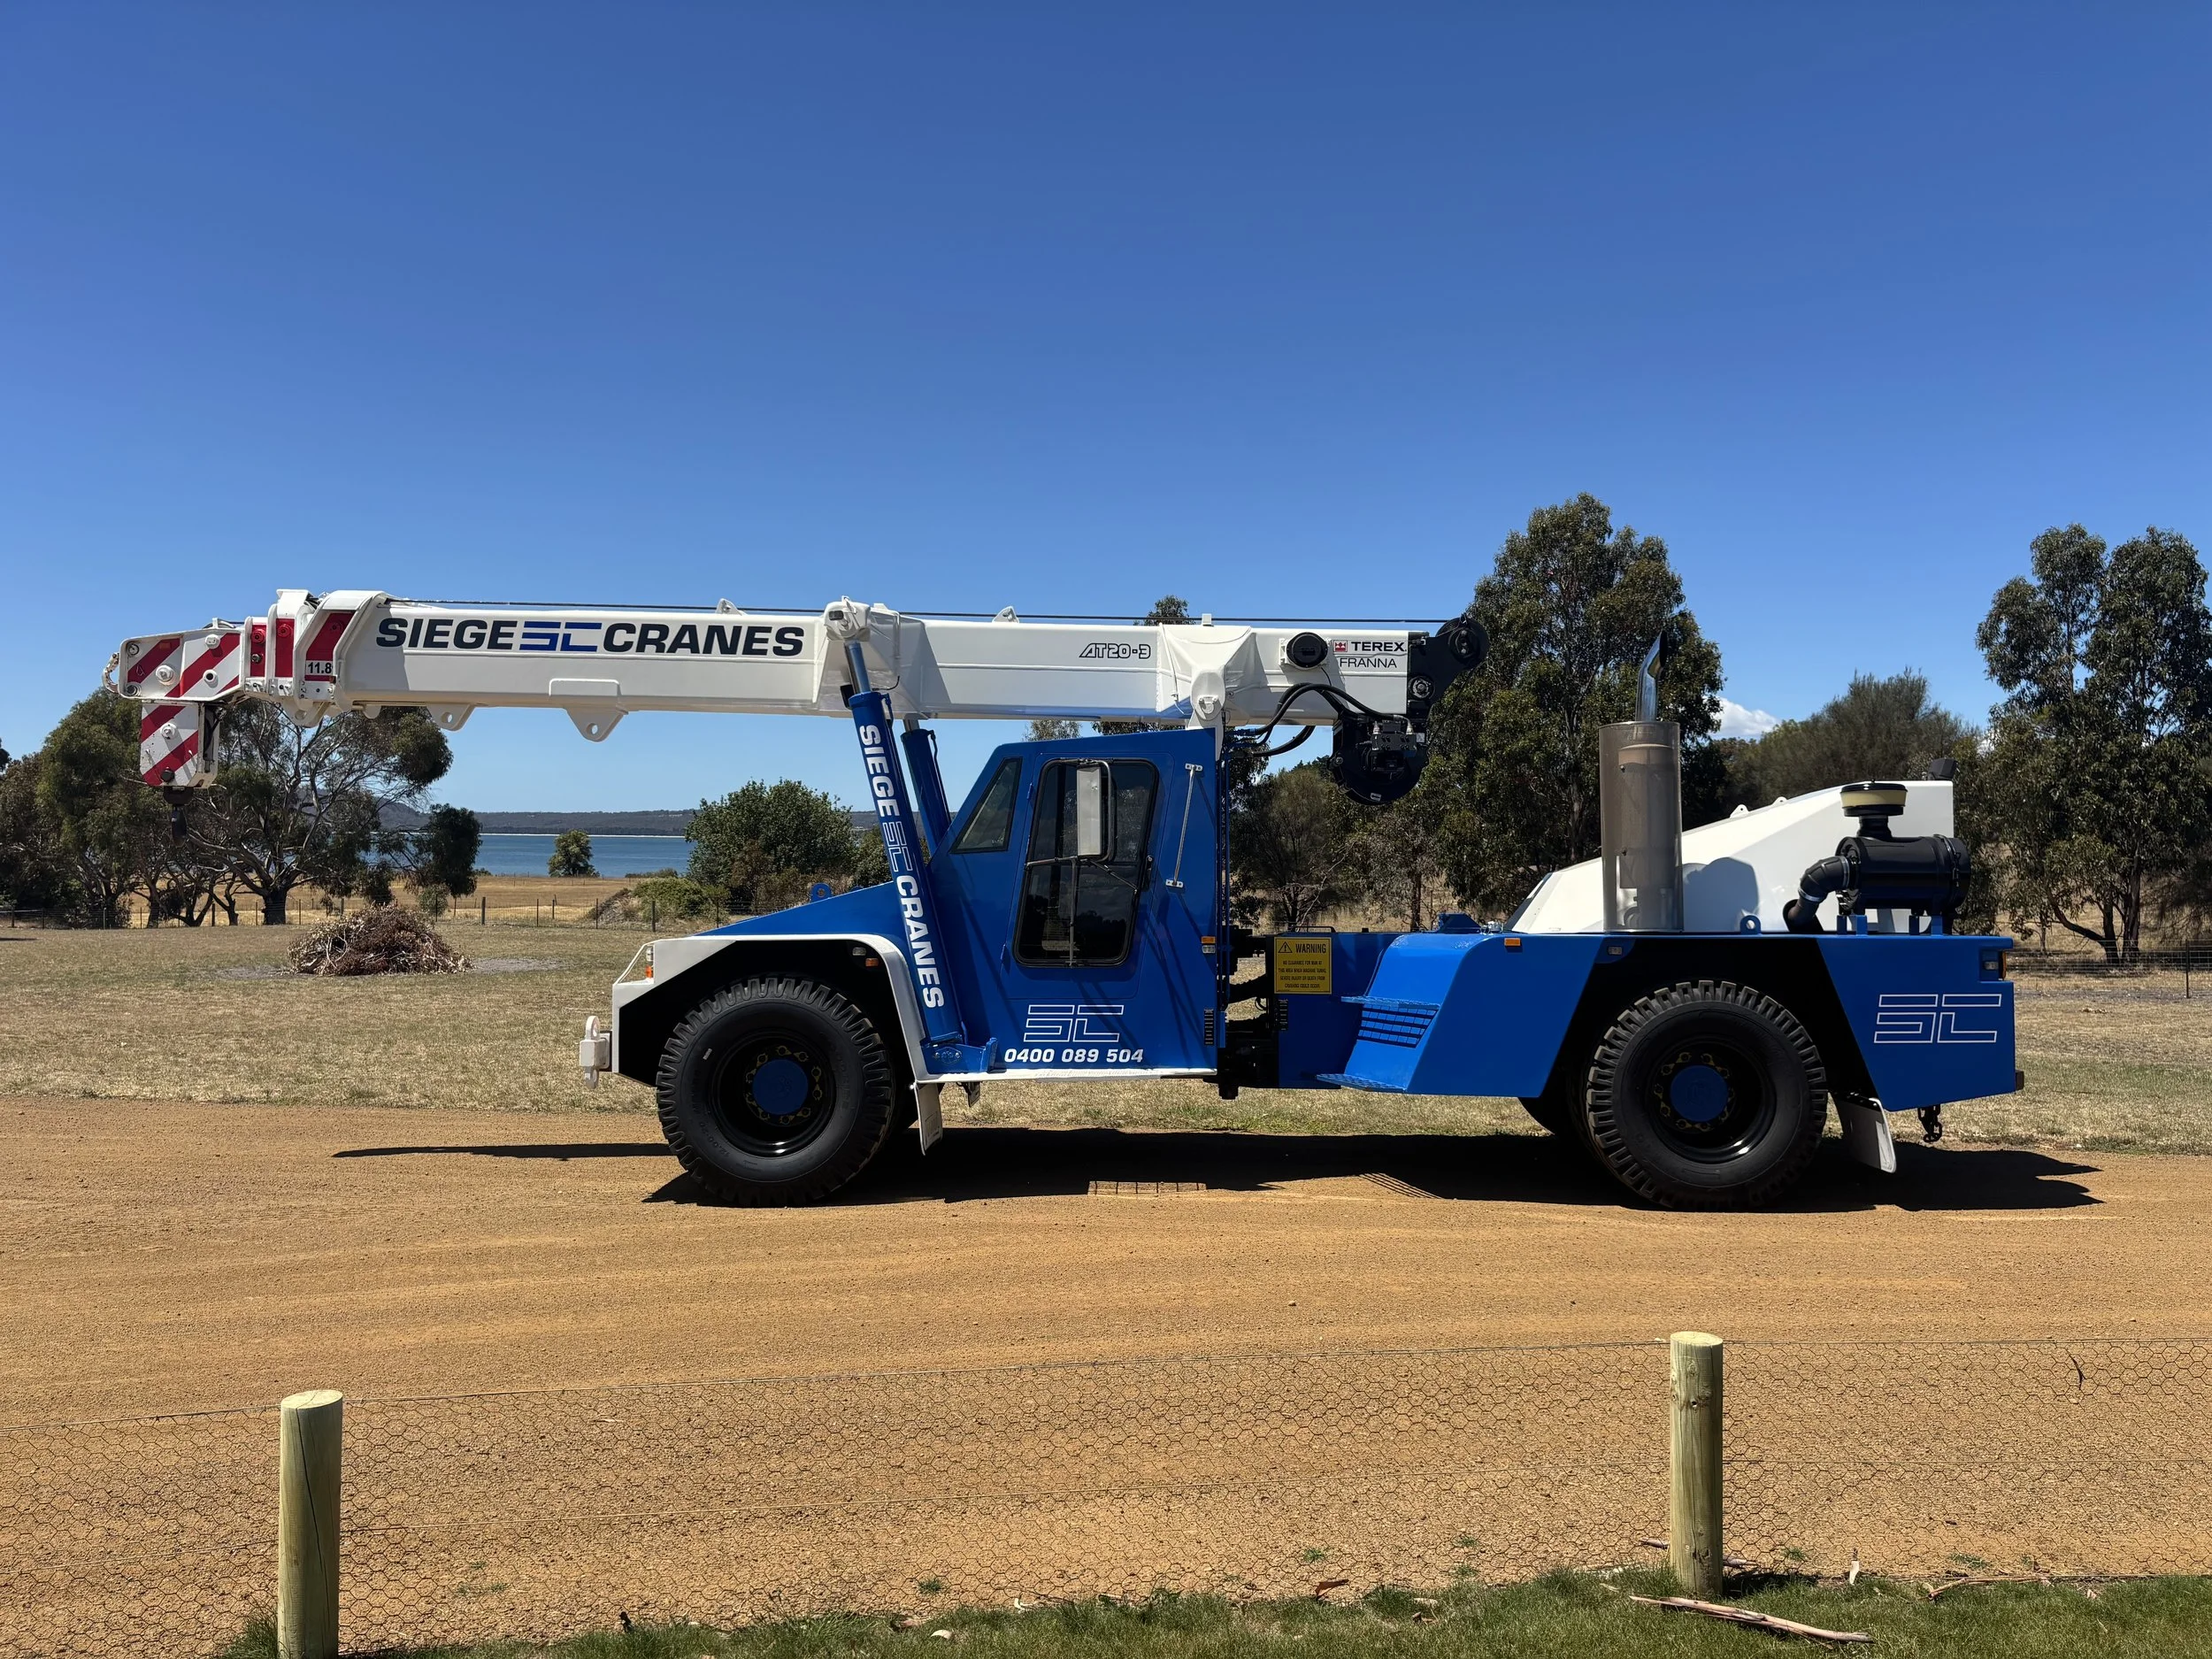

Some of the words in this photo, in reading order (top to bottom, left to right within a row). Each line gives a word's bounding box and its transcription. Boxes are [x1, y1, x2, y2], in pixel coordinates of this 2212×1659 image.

[376, 618, 518, 649] SIEGE
[603, 623, 804, 657] CRANES
[1079, 642, 1151, 659] AT20-3
[1351, 641, 1405, 652] TEREX
[308, 662, 332, 673] 11.8
[1340, 657, 1397, 668] FRANNA
[859, 725, 900, 817] SIEGE
[896, 875, 944, 1008] CRANES
[1295, 943, 1326, 954] WARNING
[1004, 1048, 1055, 1063] 0400
[1062, 1048, 1099, 1063] 089
[1106, 1048, 1143, 1063] 504
